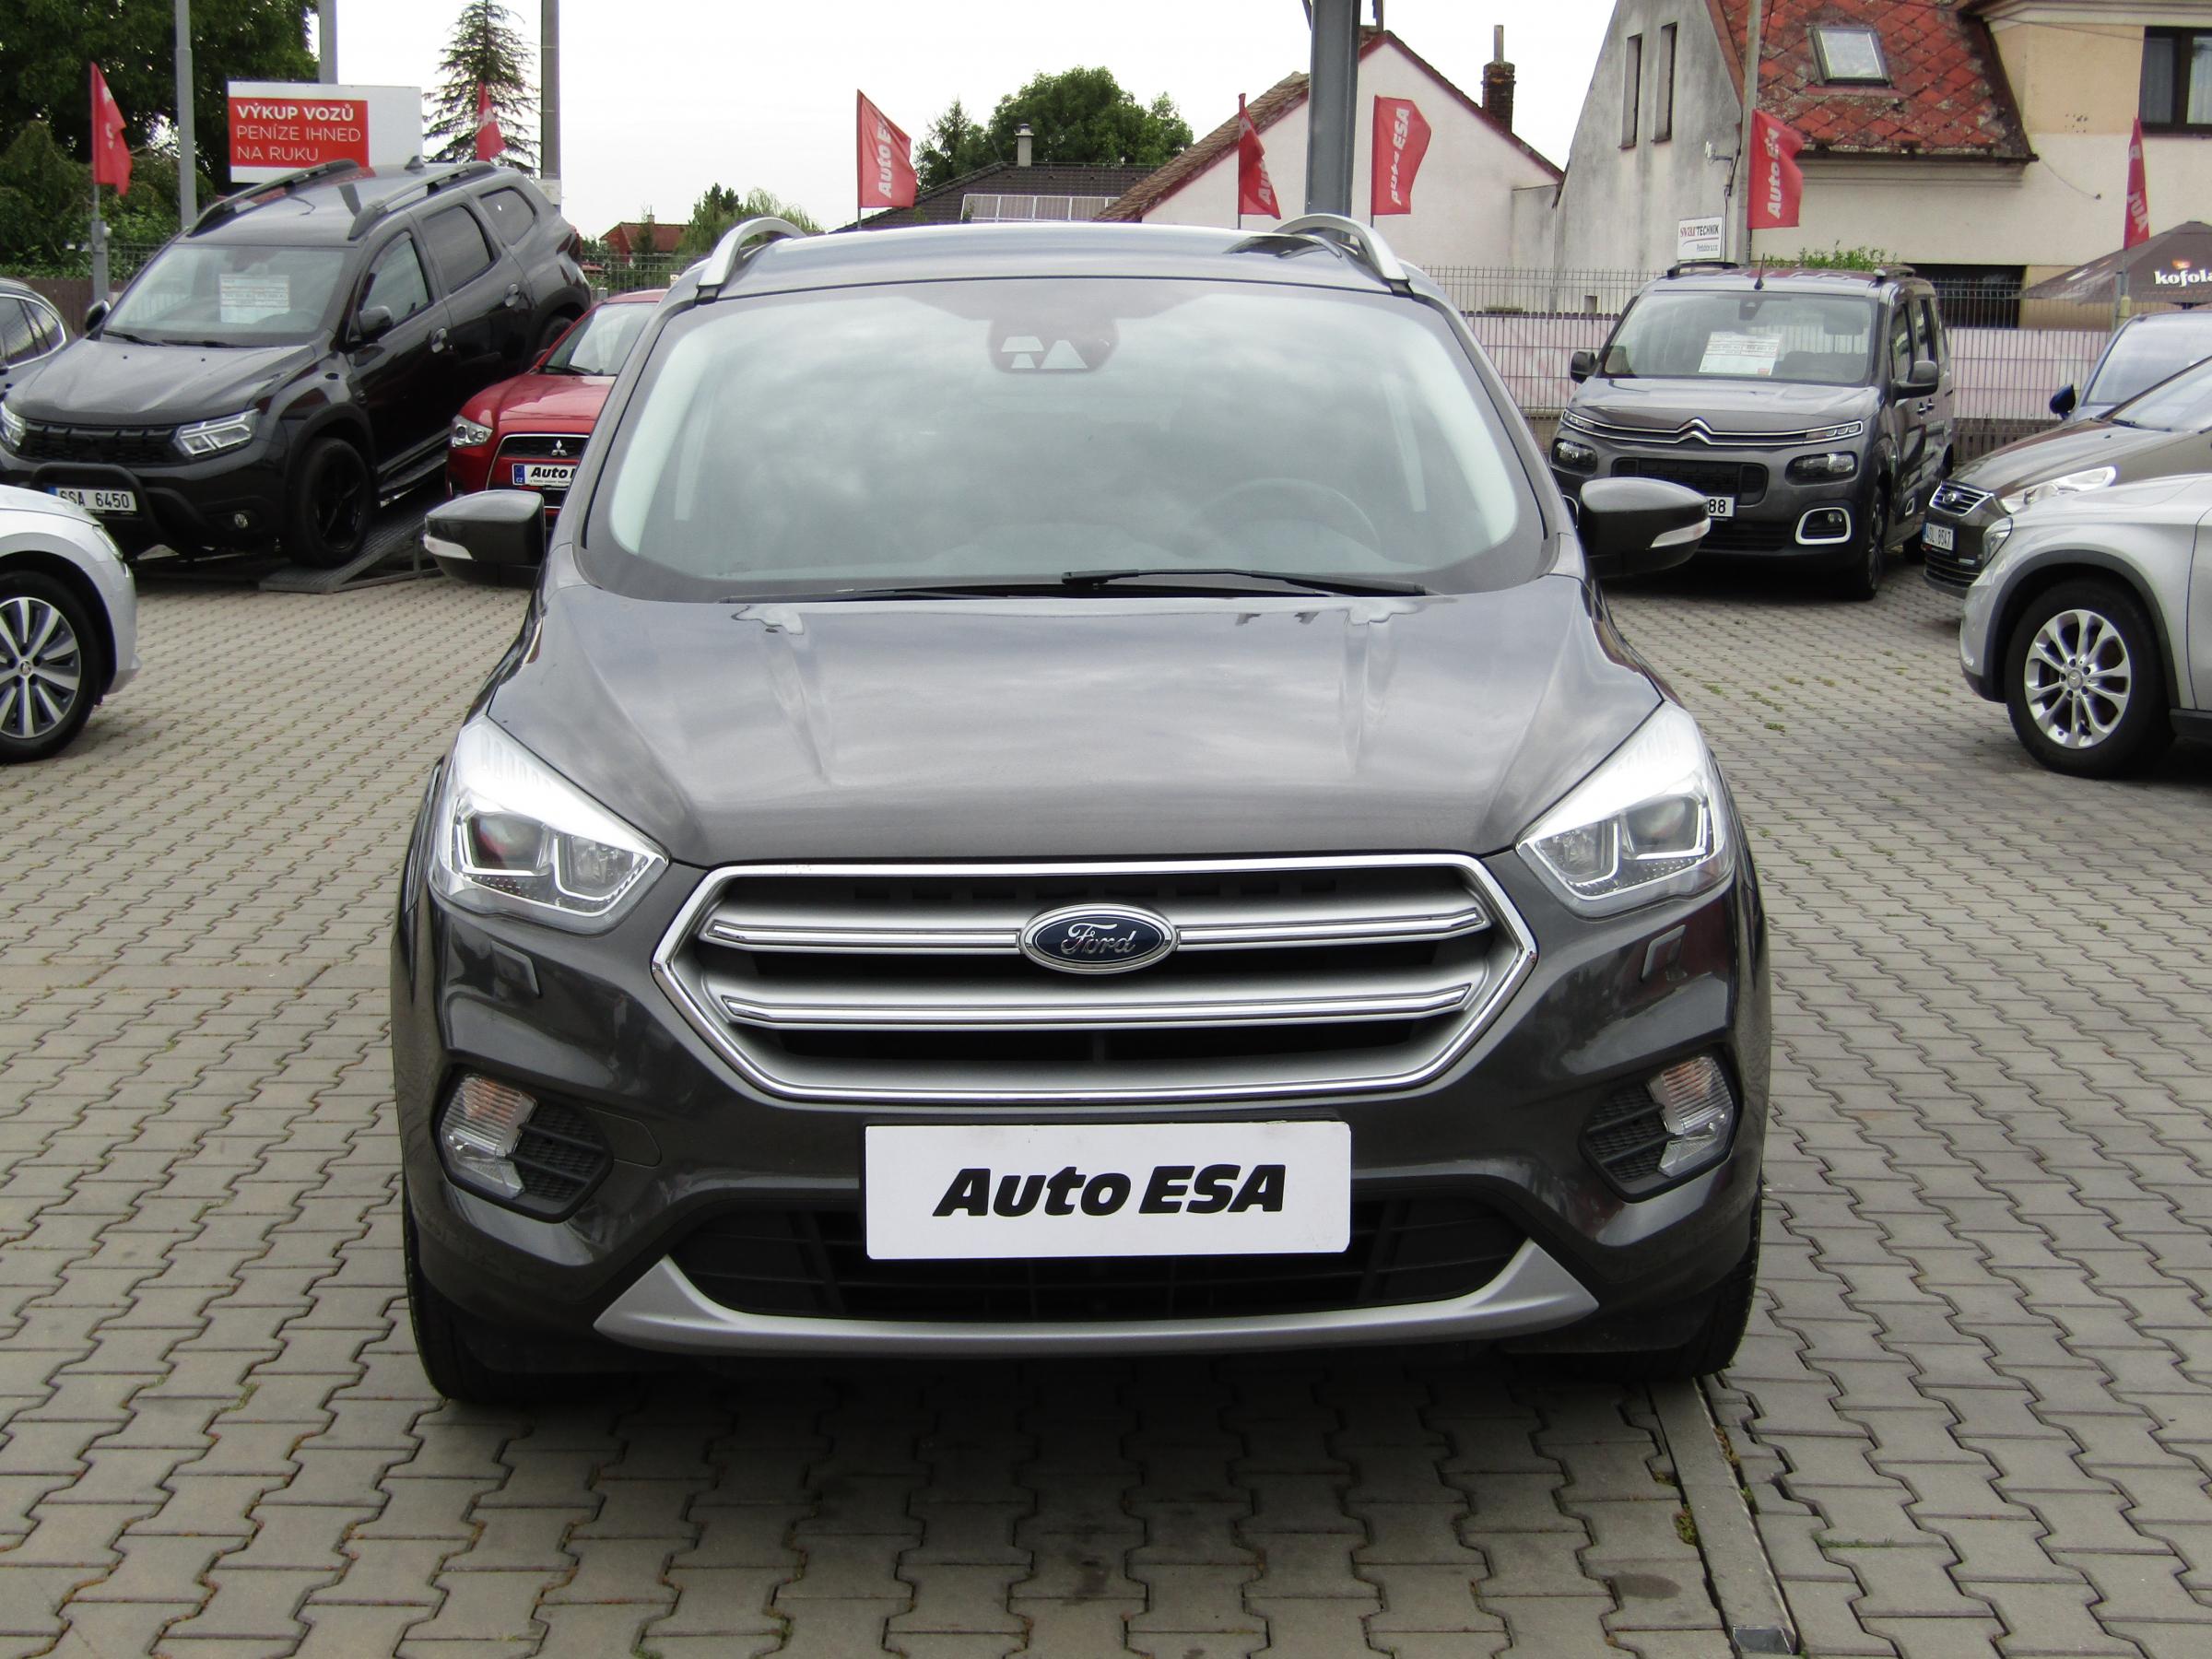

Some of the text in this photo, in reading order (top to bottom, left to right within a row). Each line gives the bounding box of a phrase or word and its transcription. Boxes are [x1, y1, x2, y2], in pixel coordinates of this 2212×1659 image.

[237, 102, 354, 122] VÝKUP VOZŮ
[237, 124, 361, 142] PENÍZE IHNED
[1393, 107, 1410, 150] ESA
[237, 147, 319, 161] NA RUKU
[877, 144, 893, 199] Auto
[1768, 161, 1782, 219] Auto
[531, 467, 569, 478] Auto
[95, 492, 130, 509] 6450
[1060, 923, 1136, 955] Ford
[932, 1164, 1286, 1218] Auto ESA
